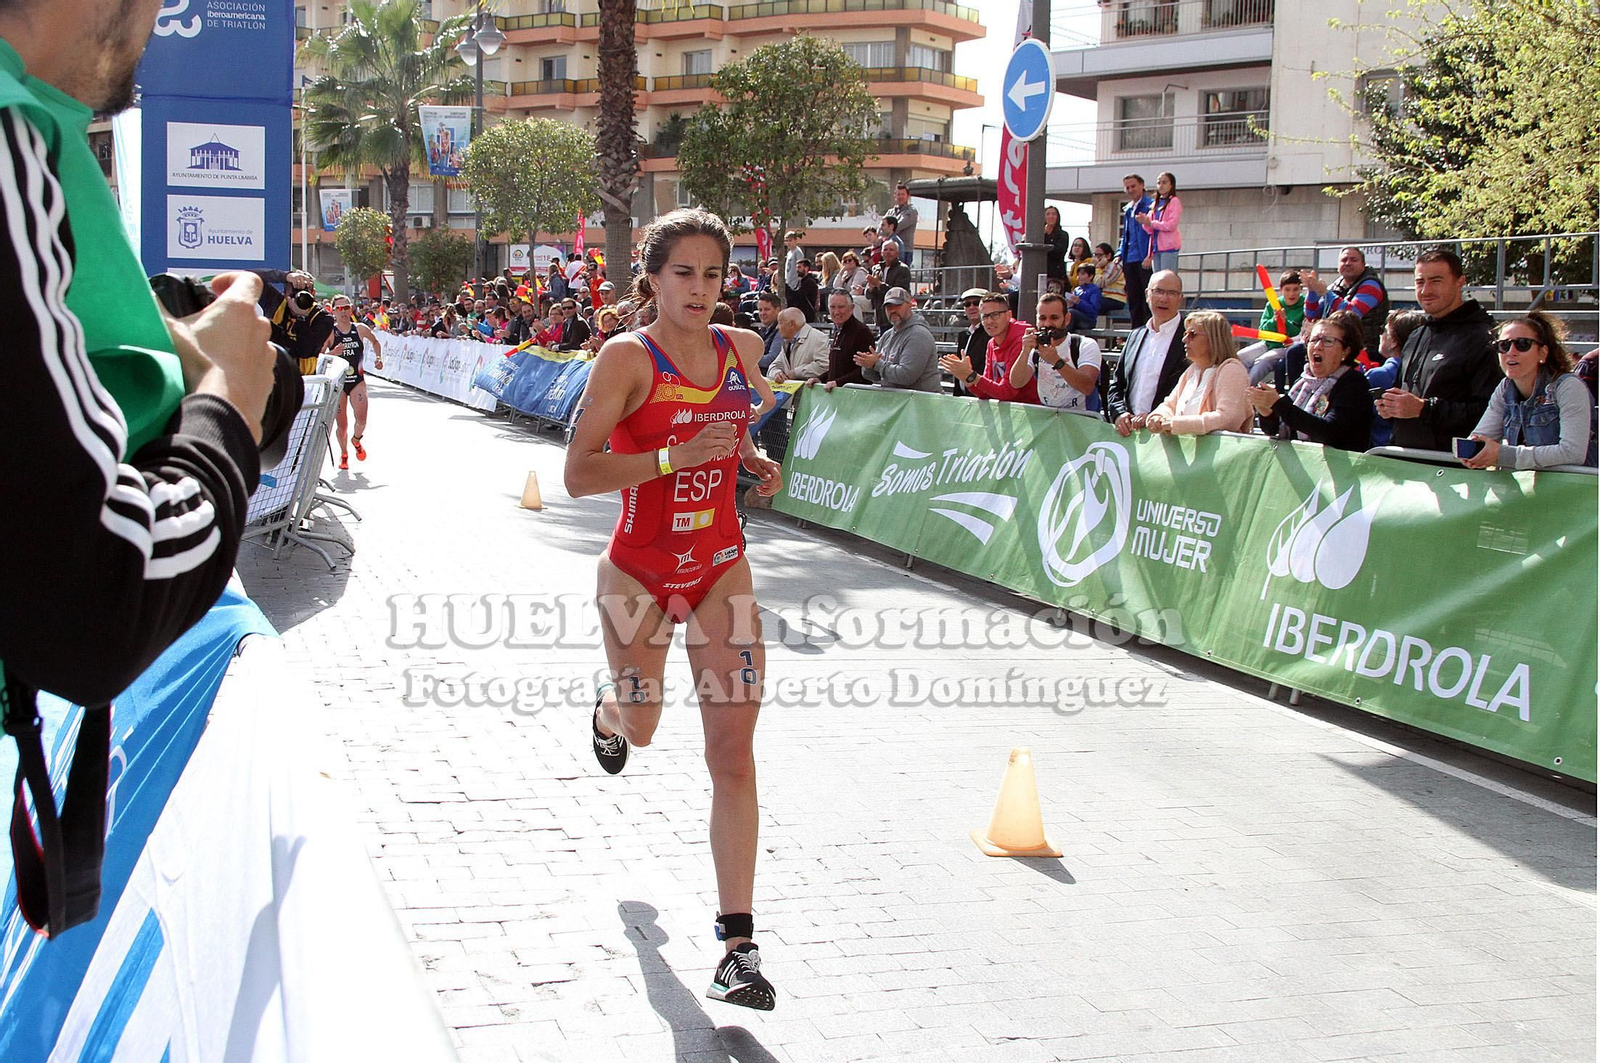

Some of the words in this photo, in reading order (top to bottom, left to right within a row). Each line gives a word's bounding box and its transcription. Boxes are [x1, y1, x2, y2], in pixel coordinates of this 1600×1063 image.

[207, 1, 266, 12] ASOCIACIÓN
[207, 20, 219, 28] DE
[222, 20, 266, 30] TRIATLÓN
[207, 235, 253, 246] HUELVA
[694, 410, 746, 422] IBERDROLA
[871, 461, 937, 498] Somos
[936, 438, 1033, 486] Triatlón
[673, 469, 723, 503] ESP
[788, 471, 861, 513] IBERDROLA
[623, 483, 640, 535] SHIMA
[675, 517, 691, 528] TM
[1136, 498, 1222, 538] UNIVERSO
[1130, 525, 1212, 573] MUJER
[662, 576, 703, 589] STEVENS
[1263, 603, 1530, 722] IBERDROLA
